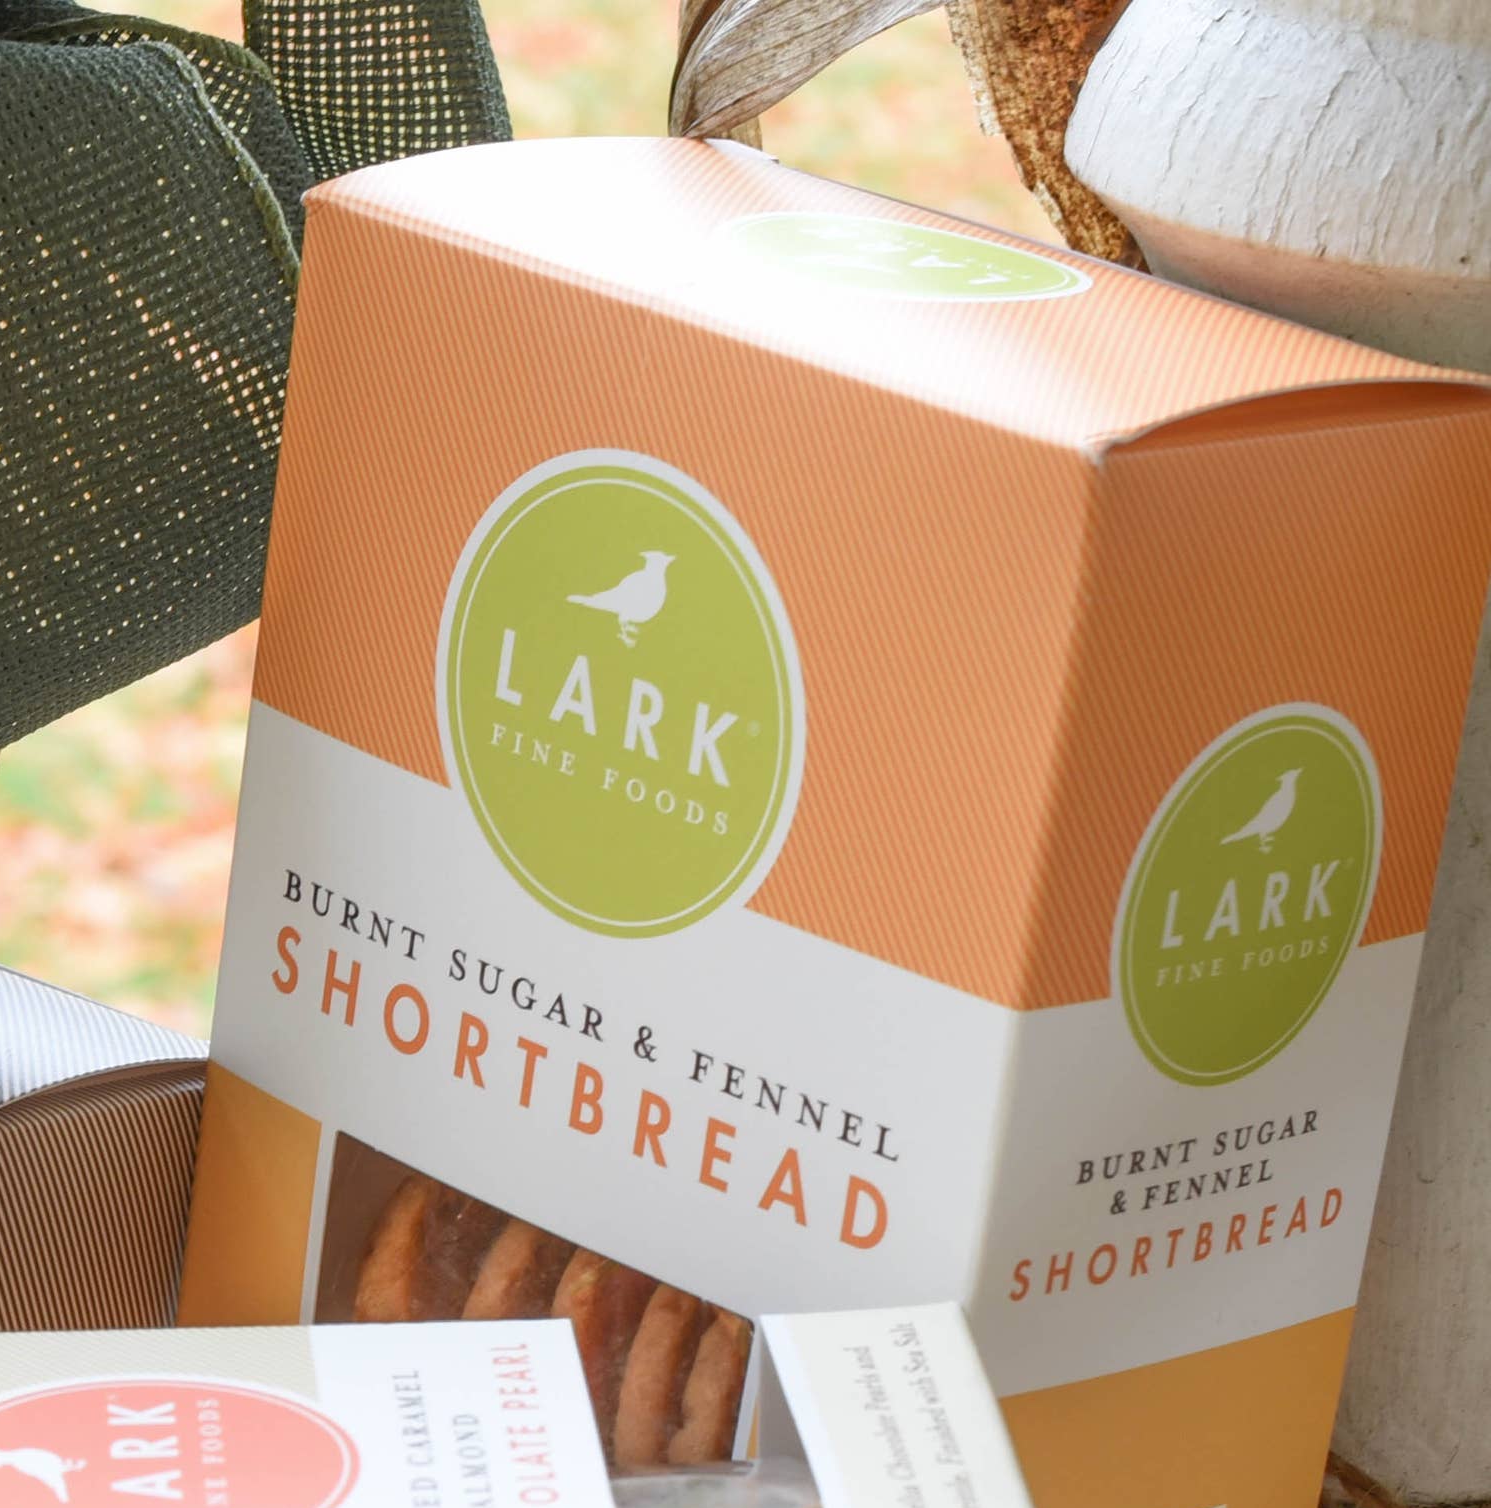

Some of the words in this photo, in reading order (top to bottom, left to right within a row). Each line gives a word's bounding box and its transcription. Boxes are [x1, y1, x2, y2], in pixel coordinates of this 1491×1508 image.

[491, 722, 575, 775] FINE
[603, 768, 729, 835] FOODS
[1161, 860, 1344, 950] LARK
[1156, 958, 1224, 987] FINE
[1242, 936, 1331, 972] FOODS
[283, 870, 425, 960] BURNT
[449, 949, 603, 1042] SUGAR
[634, 1026, 657, 1062] &
[688, 1050, 899, 1163] FENNEL
[272, 925, 888, 1250] SHORTBREAD
[1077, 1139, 1197, 1185] BURNT
[1214, 1110, 1319, 1156] SUGAR
[1110, 1190, 1127, 1215] &
[1143, 1160, 1274, 1210] FENNEL
[1010, 1187, 1343, 1302] SHORTBREAD
[392, 1369, 435, 1467] CARAMEL
[491, 1342, 544, 1410] PEARL
[196, 1397, 226, 1464] FOODS
